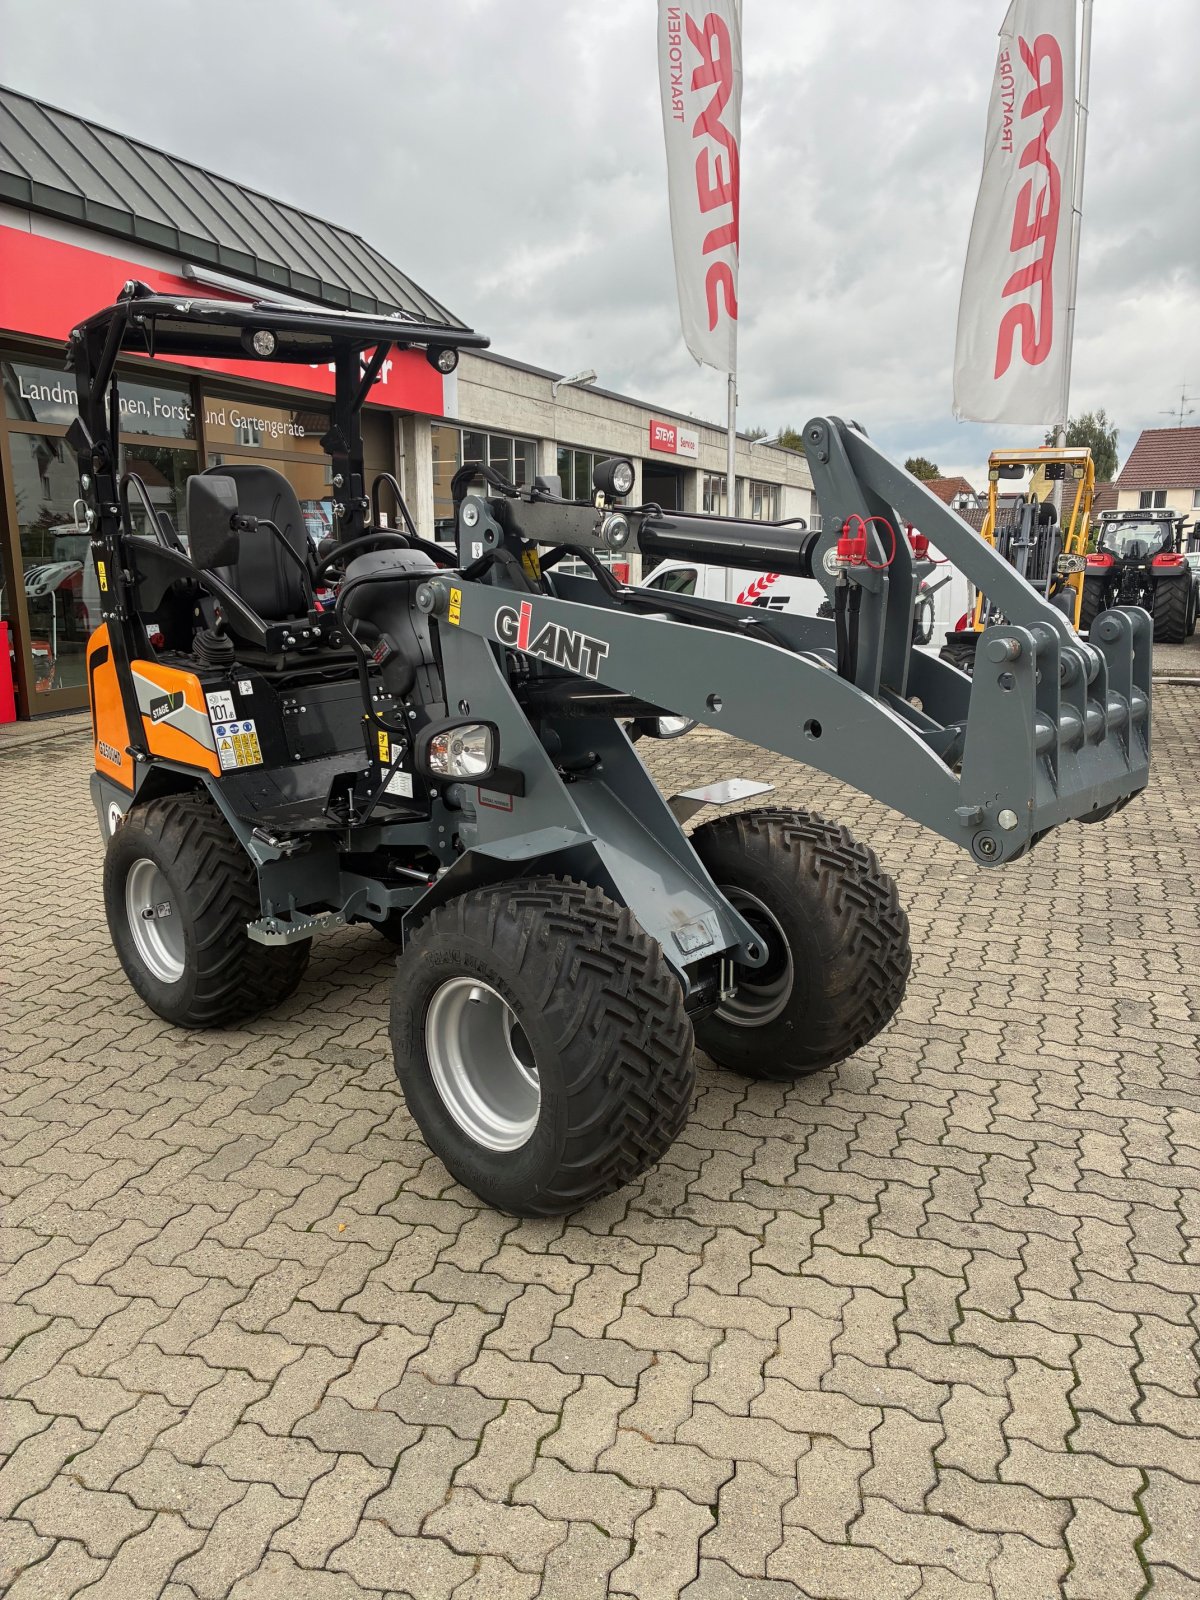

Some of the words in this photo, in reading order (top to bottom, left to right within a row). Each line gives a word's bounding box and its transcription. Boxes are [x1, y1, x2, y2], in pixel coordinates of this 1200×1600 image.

[153, 397, 196, 421] Forst-
[230, 409, 305, 438] Gartengeräte
[655, 426, 675, 443] STEYR
[680, 437, 696, 450] Service
[152, 703, 170, 719] STAGE
[210, 704, 228, 721] 101
